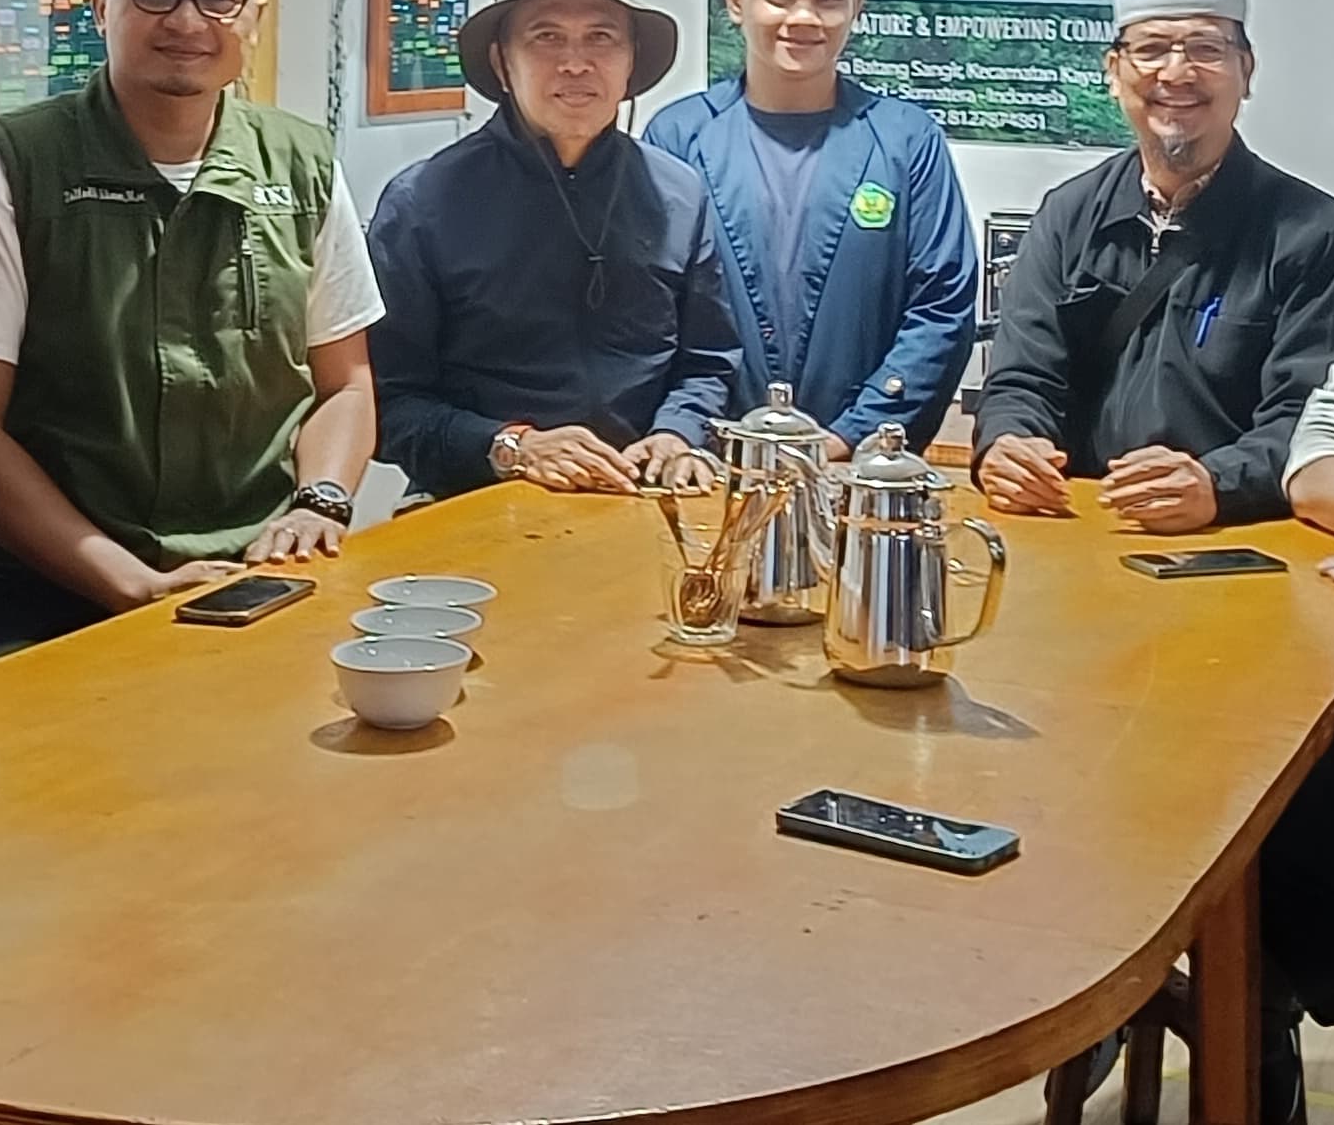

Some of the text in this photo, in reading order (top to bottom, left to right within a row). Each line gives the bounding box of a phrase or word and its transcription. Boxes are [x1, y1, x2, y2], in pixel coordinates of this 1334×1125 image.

[916, 17, 930, 37] &
[935, 16, 1057, 41] EMPOWERING
[1061, 20, 1119, 44] COMM
[853, 58, 909, 81] Batang
[966, 62, 1059, 83] Kecamatan
[898, 84, 977, 105] Sumatera
[985, 87, 1068, 107] Indonesia
